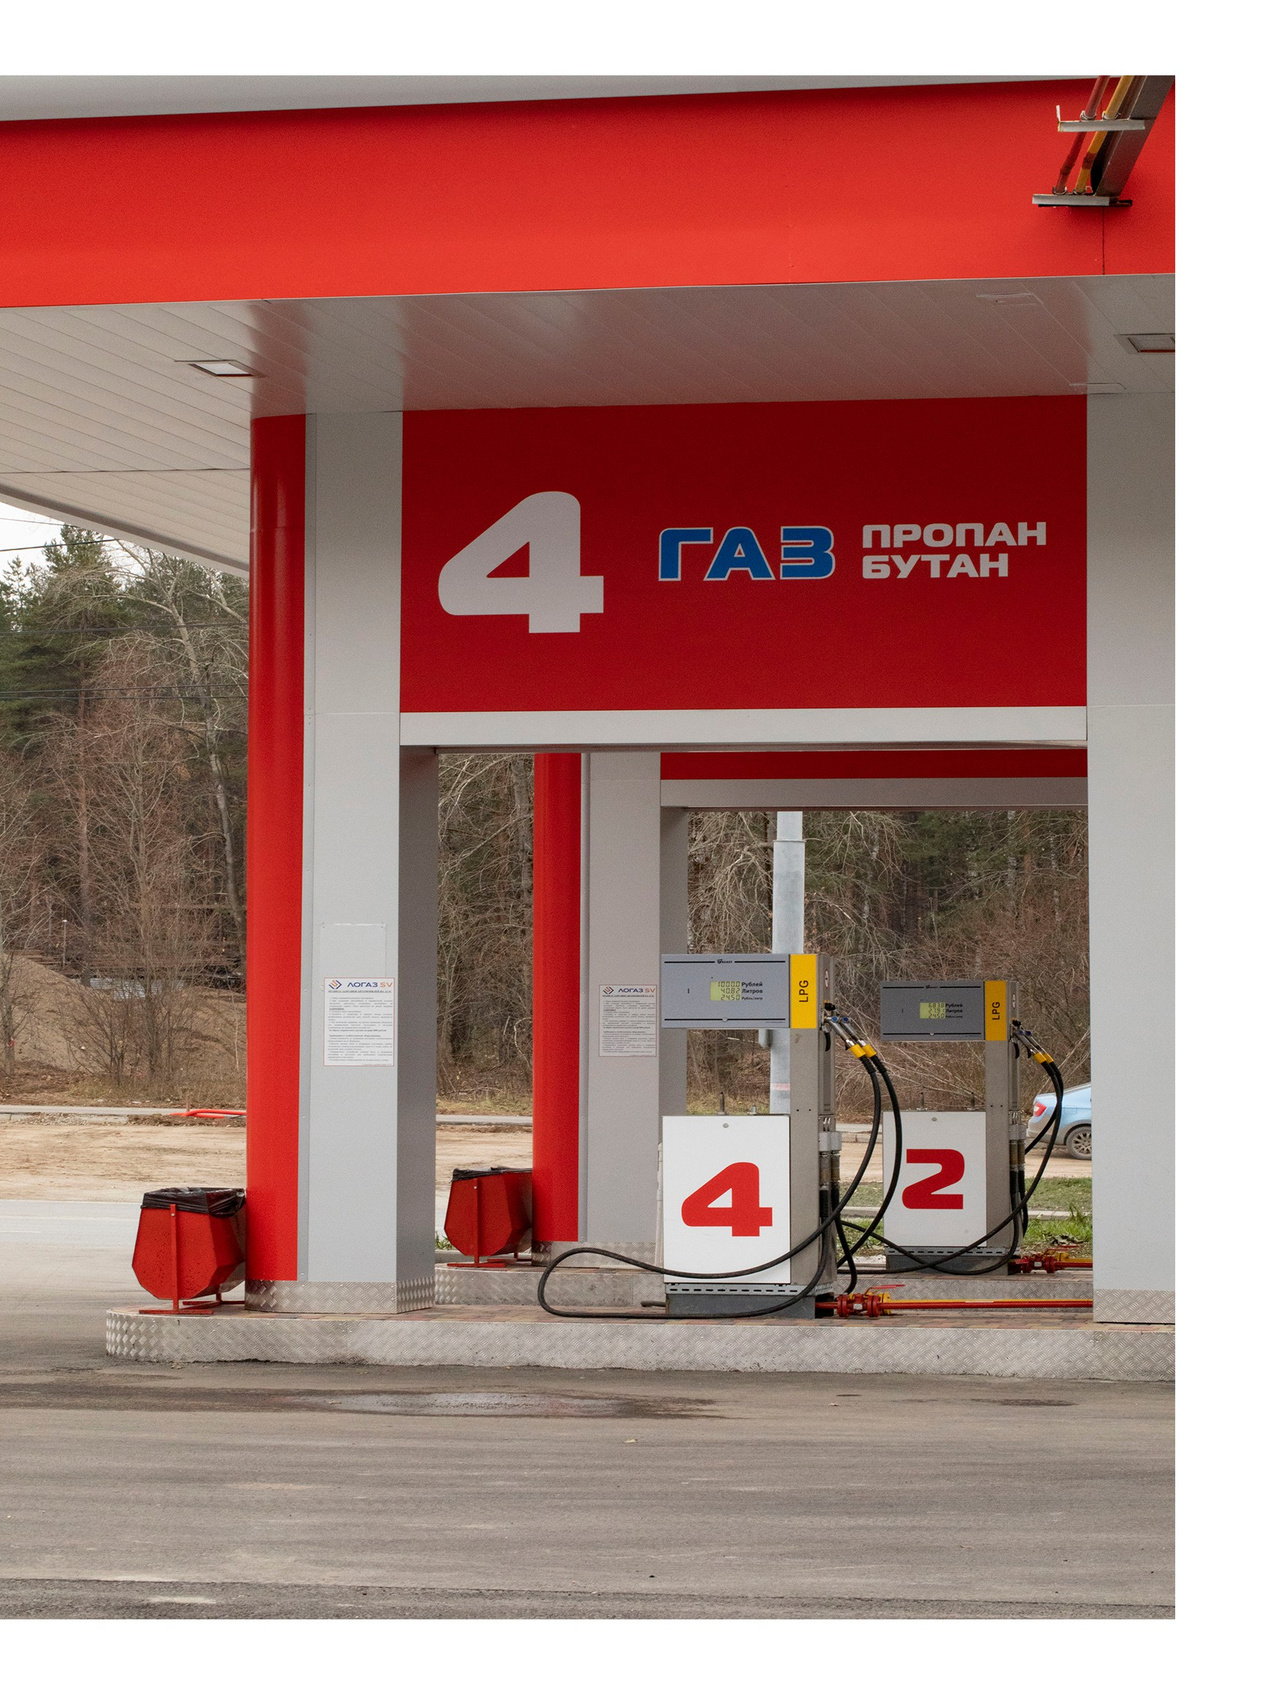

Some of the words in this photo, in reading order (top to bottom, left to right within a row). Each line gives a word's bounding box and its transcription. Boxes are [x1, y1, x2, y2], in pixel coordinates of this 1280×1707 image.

[658, 525, 835, 582] ГАЗ
[862, 521, 1047, 549] ПРОПАН
[438, 490, 604, 634] 4
[862, 553, 1009, 579] БУТАН
[799, 980, 809, 1003] LPG
[991, 1001, 1001, 1021] LPG
[681, 1161, 773, 1237] 4
[901, 1148, 966, 1210] 2
